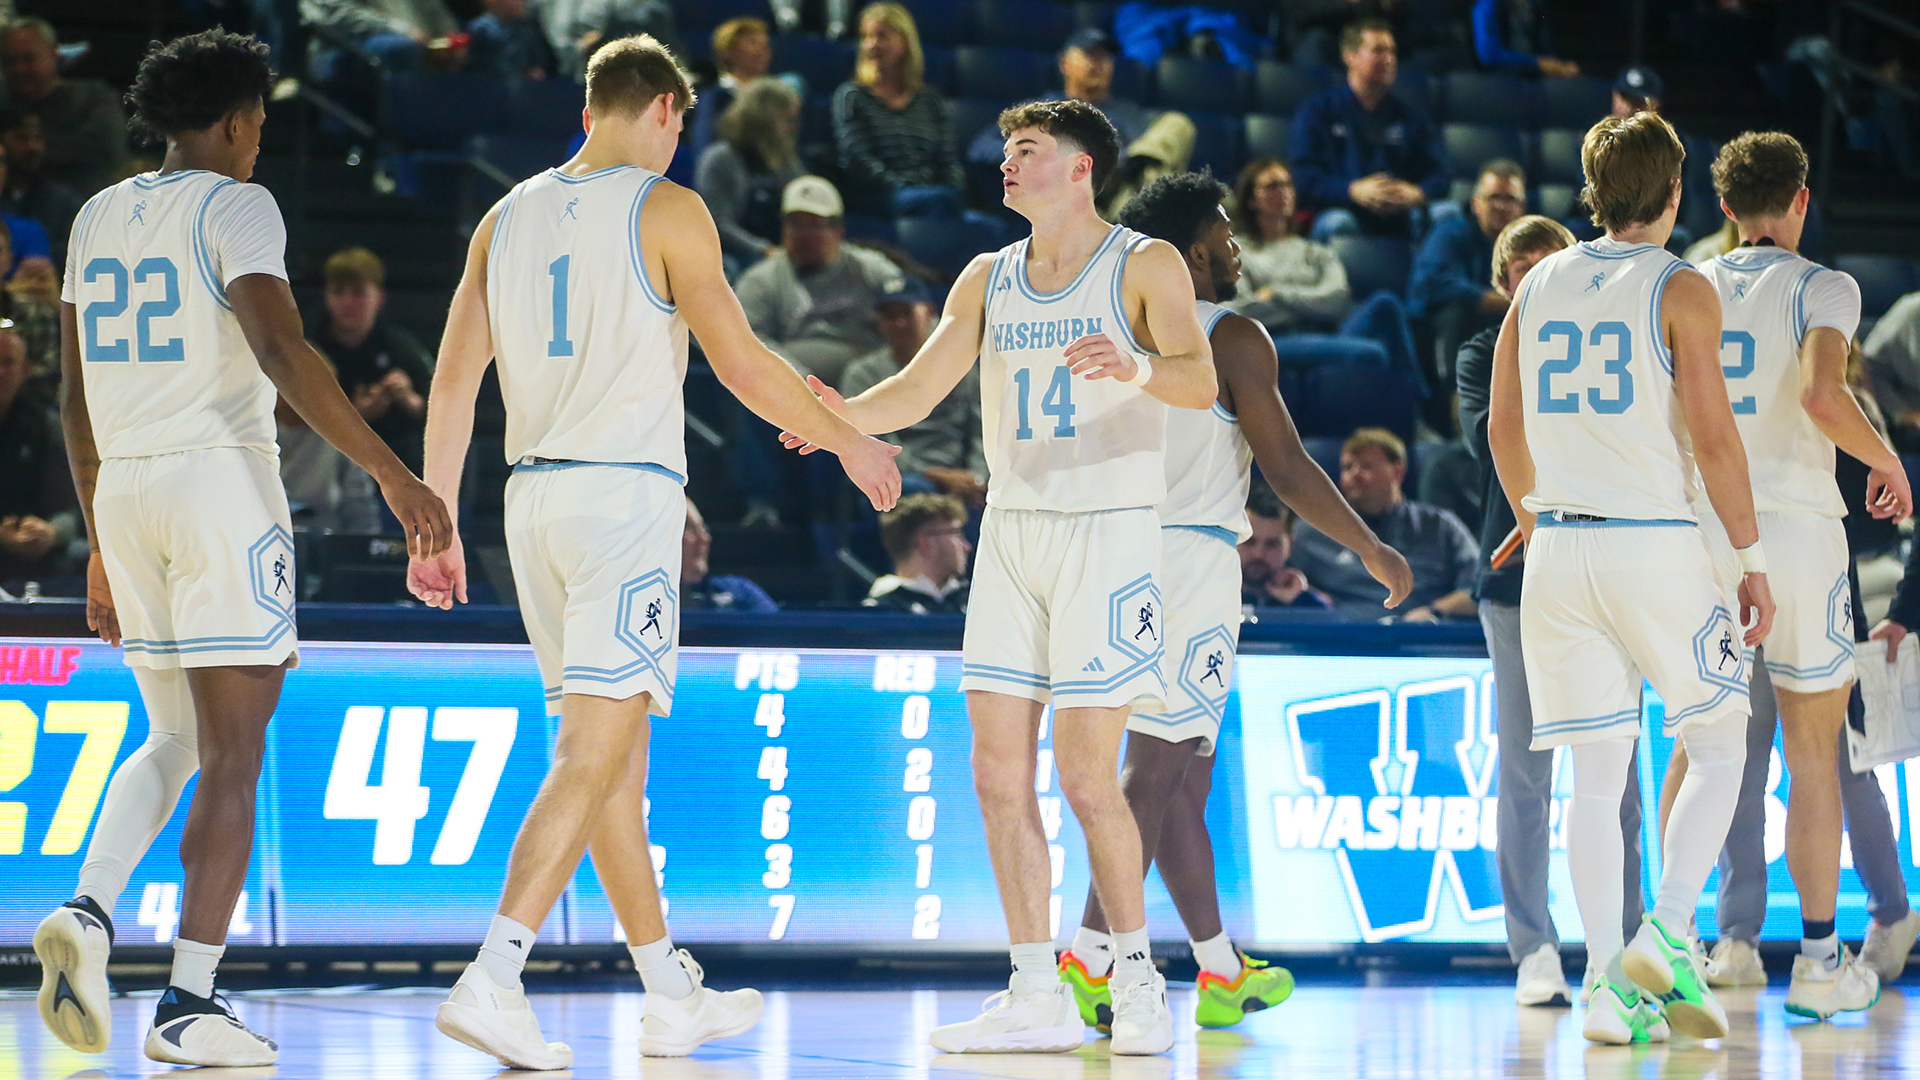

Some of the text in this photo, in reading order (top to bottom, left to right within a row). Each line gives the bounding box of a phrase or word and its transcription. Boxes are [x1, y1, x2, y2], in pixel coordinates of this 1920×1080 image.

[83, 257, 185, 363] 22
[548, 254, 574, 358] 1
[992, 317, 1103, 353] WASHBURN
[1537, 320, 1634, 415] 23
[1014, 365, 1076, 440] 14
[734, 653, 937, 692] PTS REB
[754, 693, 931, 739] 4 0
[323, 705, 519, 866] 47
[757, 746, 788, 791] 4
[903, 748, 933, 792] 2
[760, 794, 792, 840] 6
[906, 795, 937, 840] 0
[762, 843, 793, 889] 3
[915, 843, 934, 889] 1
[138, 882, 179, 943] 4
[768, 894, 796, 941] 7
[911, 894, 942, 940] 2
